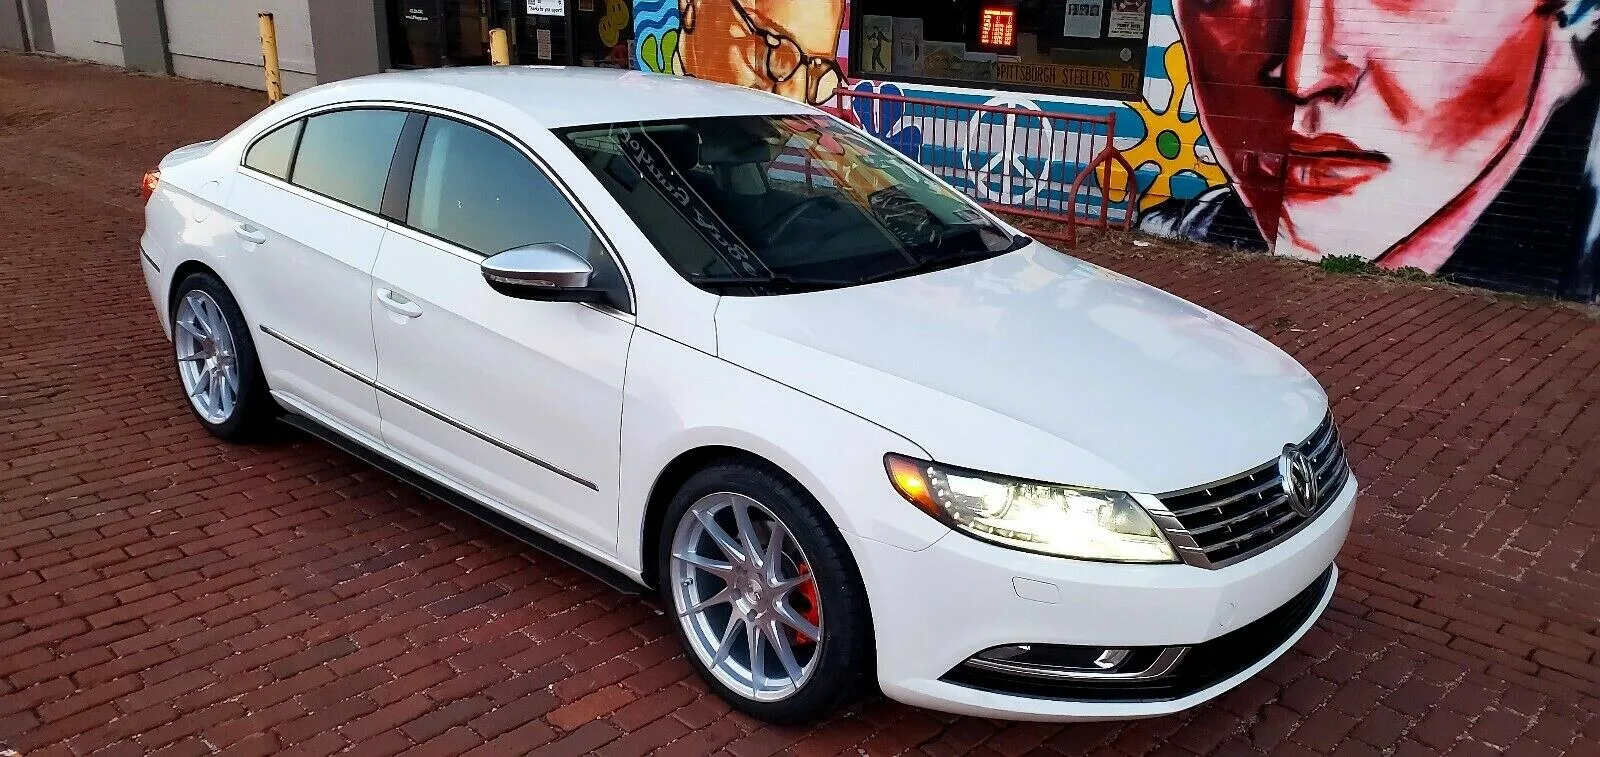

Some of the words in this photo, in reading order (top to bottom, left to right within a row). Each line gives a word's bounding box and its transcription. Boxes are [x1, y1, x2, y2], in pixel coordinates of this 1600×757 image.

[1001, 64, 1056, 84] PITTSBURGH
[1062, 68, 1110, 88] STEELERS
[1121, 72, 1135, 89] DR
